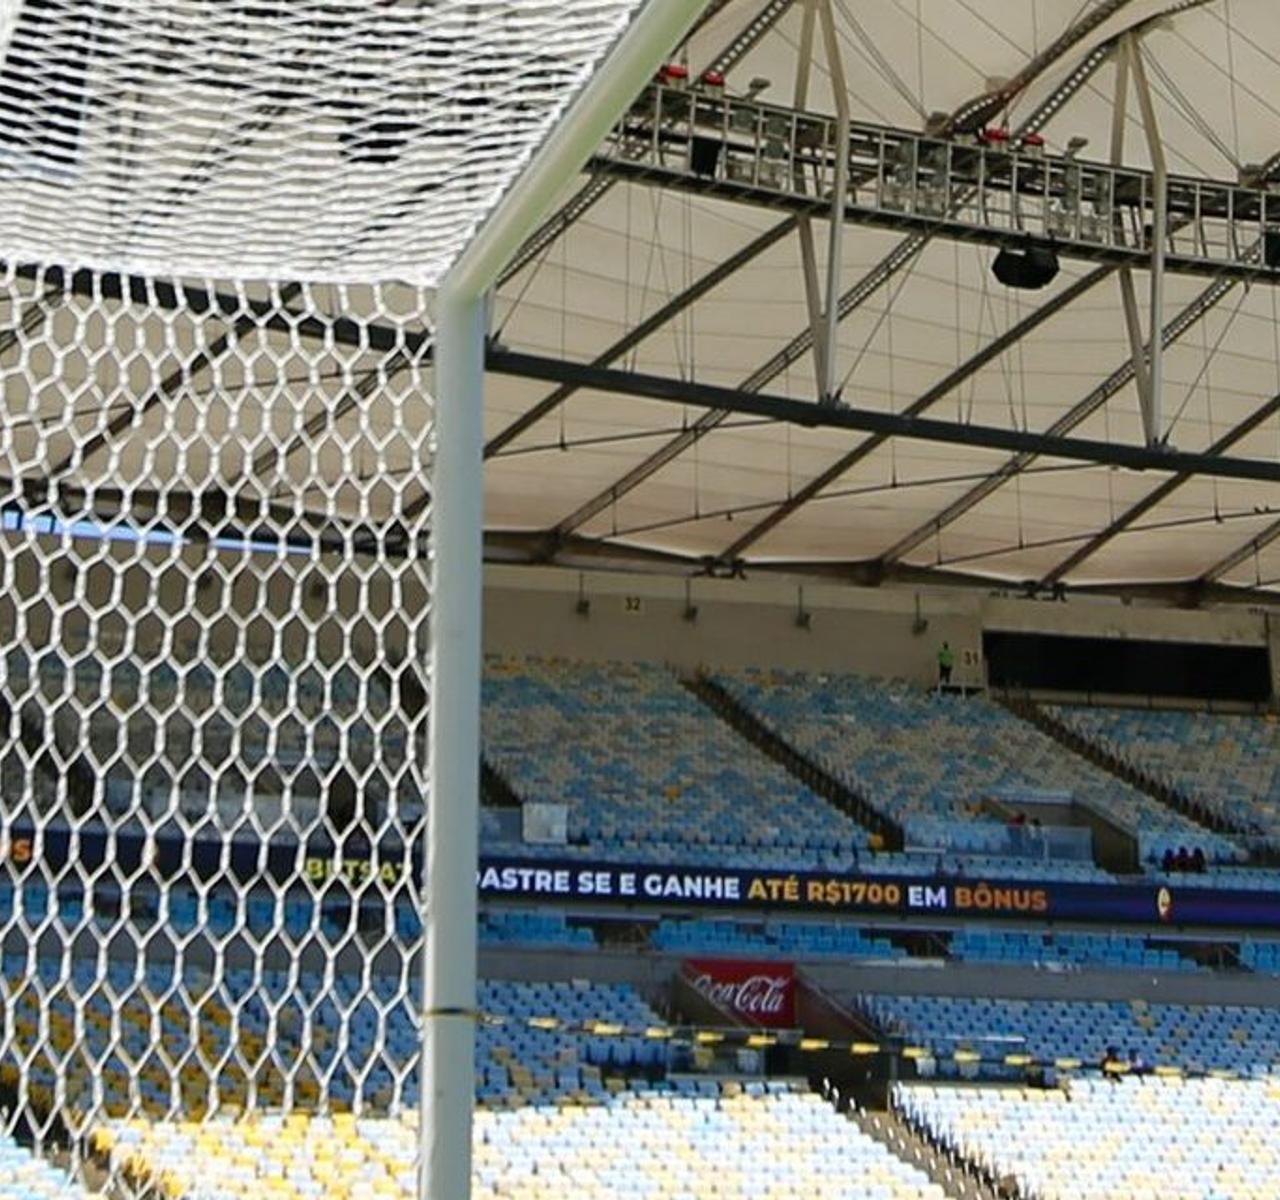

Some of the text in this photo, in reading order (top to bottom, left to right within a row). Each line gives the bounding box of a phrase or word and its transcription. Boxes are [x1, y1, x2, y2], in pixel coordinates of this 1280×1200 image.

[475, 867, 570, 893] ASTRE
[578, 872, 612, 894] SE
[620, 874, 636, 895] E
[644, 875, 740, 899] GANHE
[748, 874, 800, 901] ATÉ
[807, 879, 900, 905] R$1700
[908, 886, 947, 908] EM
[954, 883, 1048, 911] BÔNUS
